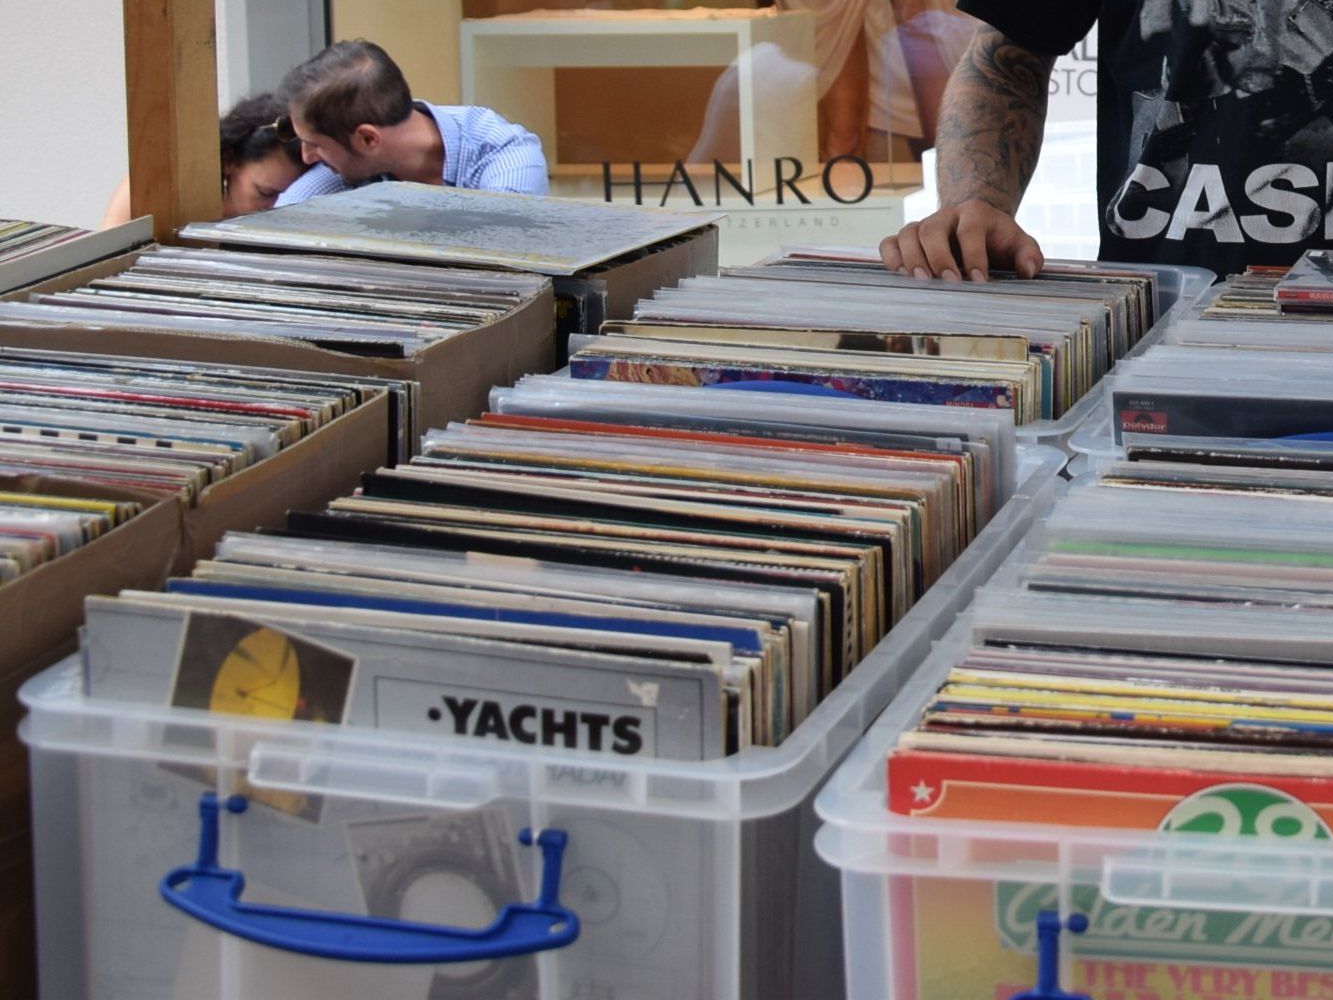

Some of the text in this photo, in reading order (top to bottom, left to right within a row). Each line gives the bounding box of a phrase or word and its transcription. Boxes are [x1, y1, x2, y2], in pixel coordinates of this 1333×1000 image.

[602, 154, 875, 207] HANRO
[727, 215, 840, 229] TZERLAND
[442, 694, 643, 755] YACHTS
[1006, 876, 1209, 951] Glden
[1081, 959, 1157, 988] THE
[1166, 963, 1256, 996] VERY
